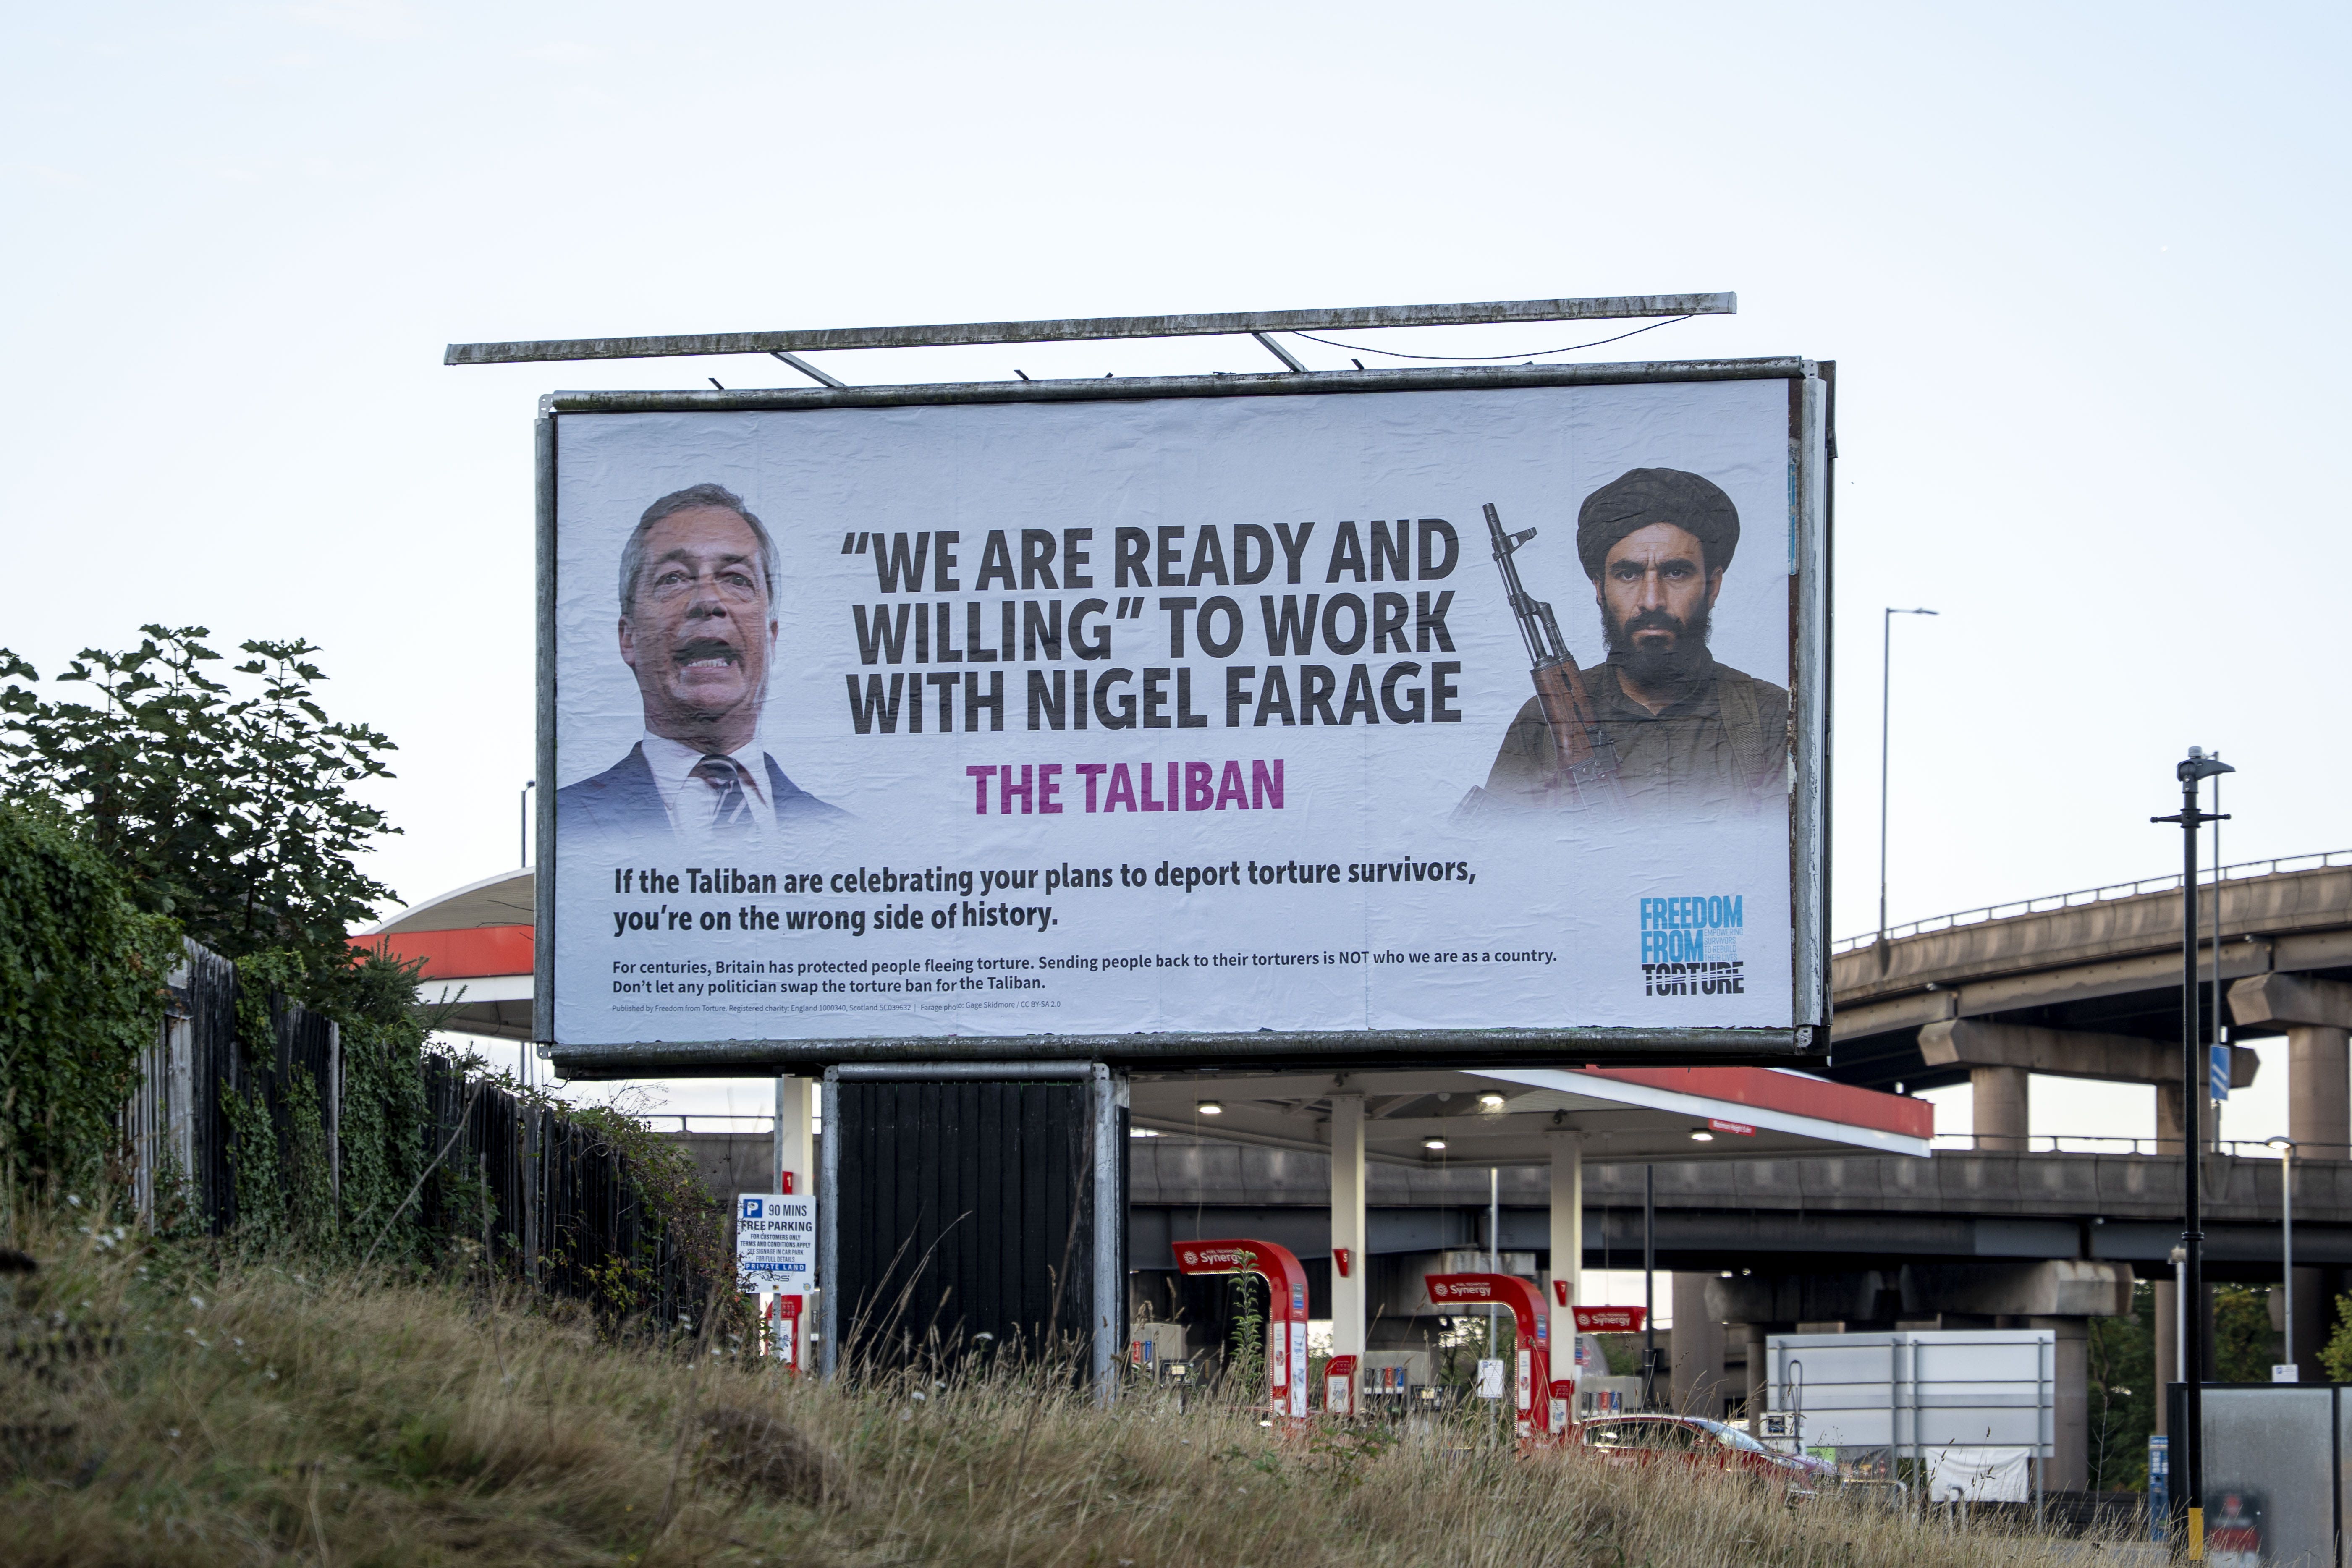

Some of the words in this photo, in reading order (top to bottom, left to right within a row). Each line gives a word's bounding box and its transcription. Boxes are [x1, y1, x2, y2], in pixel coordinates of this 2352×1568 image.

[975, 528, 1093, 591] ARE
[1115, 522, 1315, 588] READY
[1325, 519, 1459, 583] AND
[1159, 596, 1243, 658] TO
[1260, 591, 1456, 656] WORK
[846, 671, 1003, 734] WITH
[1027, 667, 1207, 730] NIGEL
[1226, 661, 1461, 727] FARAGE
[966, 764, 1063, 815] THE
[1076, 759, 1284, 813] TALIBAN
[616, 868, 633, 893] If
[639, 868, 679, 893] the
[686, 868, 776, 893] Taliban
[784, 874, 822, 893] are
[830, 866, 972, 896] celebrating
[980, 870, 1038, 896] your
[1046, 863, 1113, 895] plans
[1120, 864, 1147, 887] to
[1155, 861, 1240, 893] deport
[1248, 860, 1340, 884] torture
[1348, 856, 1476, 884] survivors,
[700, 912, 731, 930] on
[739, 905, 779, 930] the
[786, 911, 865, 936] wrong
[873, 904, 923, 929] side
[931, 903, 957, 929] of
[963, 901, 1057, 932] history.
[1641, 895, 1742, 930] FREEDOM
[613, 961, 636, 973] For
[640, 960, 711, 976] centuries,
[716, 960, 764, 973] Britain
[769, 960, 793, 973] has
[798, 960, 867, 976] protected
[872, 959, 920, 975] people
[925, 958, 973, 973] fleeing
[977, 958, 1034, 969] torture.
[1039, 955, 1098, 971] Sending
[1103, 955, 1151, 971] people
[1156, 954, 1190, 967] back
[1194, 955, 1208, 966] to
[1213, 953, 1248, 966] their
[1252, 953, 1319, 966] torturers
[1324, 951, 1335, 964] is
[1339, 951, 1369, 964] NOT
[1373, 950, 1404, 963] who
[1409, 953, 1430, 963] we
[1434, 953, 1458, 962] are
[1462, 953, 1478, 962] as
[1482, 952, 1490, 962] a
[1495, 950, 1556, 965] country.
[1642, 930, 1703, 963] FROM
[656, 980, 674, 993] let
[678, 984, 704, 996] any
[708, 980, 776, 996] politician
[781, 983, 818, 995] swap
[822, 979, 846, 992] the
[849, 980, 901, 992] torture
[906, 979, 932, 992] ban
[936, 979, 957, 992] for
[959, 976, 983, 989] the
[987, 976, 1045, 989] Taliban.
[1642, 961, 1744, 996] TORTURE
[646, 1005, 654, 1013] by
[729, 1005, 763, 1013] Registered
[765, 1005, 789, 1013] charity:
[791, 1005, 817, 1013] England
[944, 1003, 964, 1012] phoo:
[786, 1176, 791, 1187] 1
[747, 1202, 758, 1216] P
[769, 1204, 780, 1216] 90
[783, 1205, 807, 1217] MINS
[741, 1221, 766, 1230] FREE
[768, 1222, 812, 1232] PARKING
[1450, 1284, 1491, 1296] Synergy
[1591, 1314, 1630, 1326] Synergy
